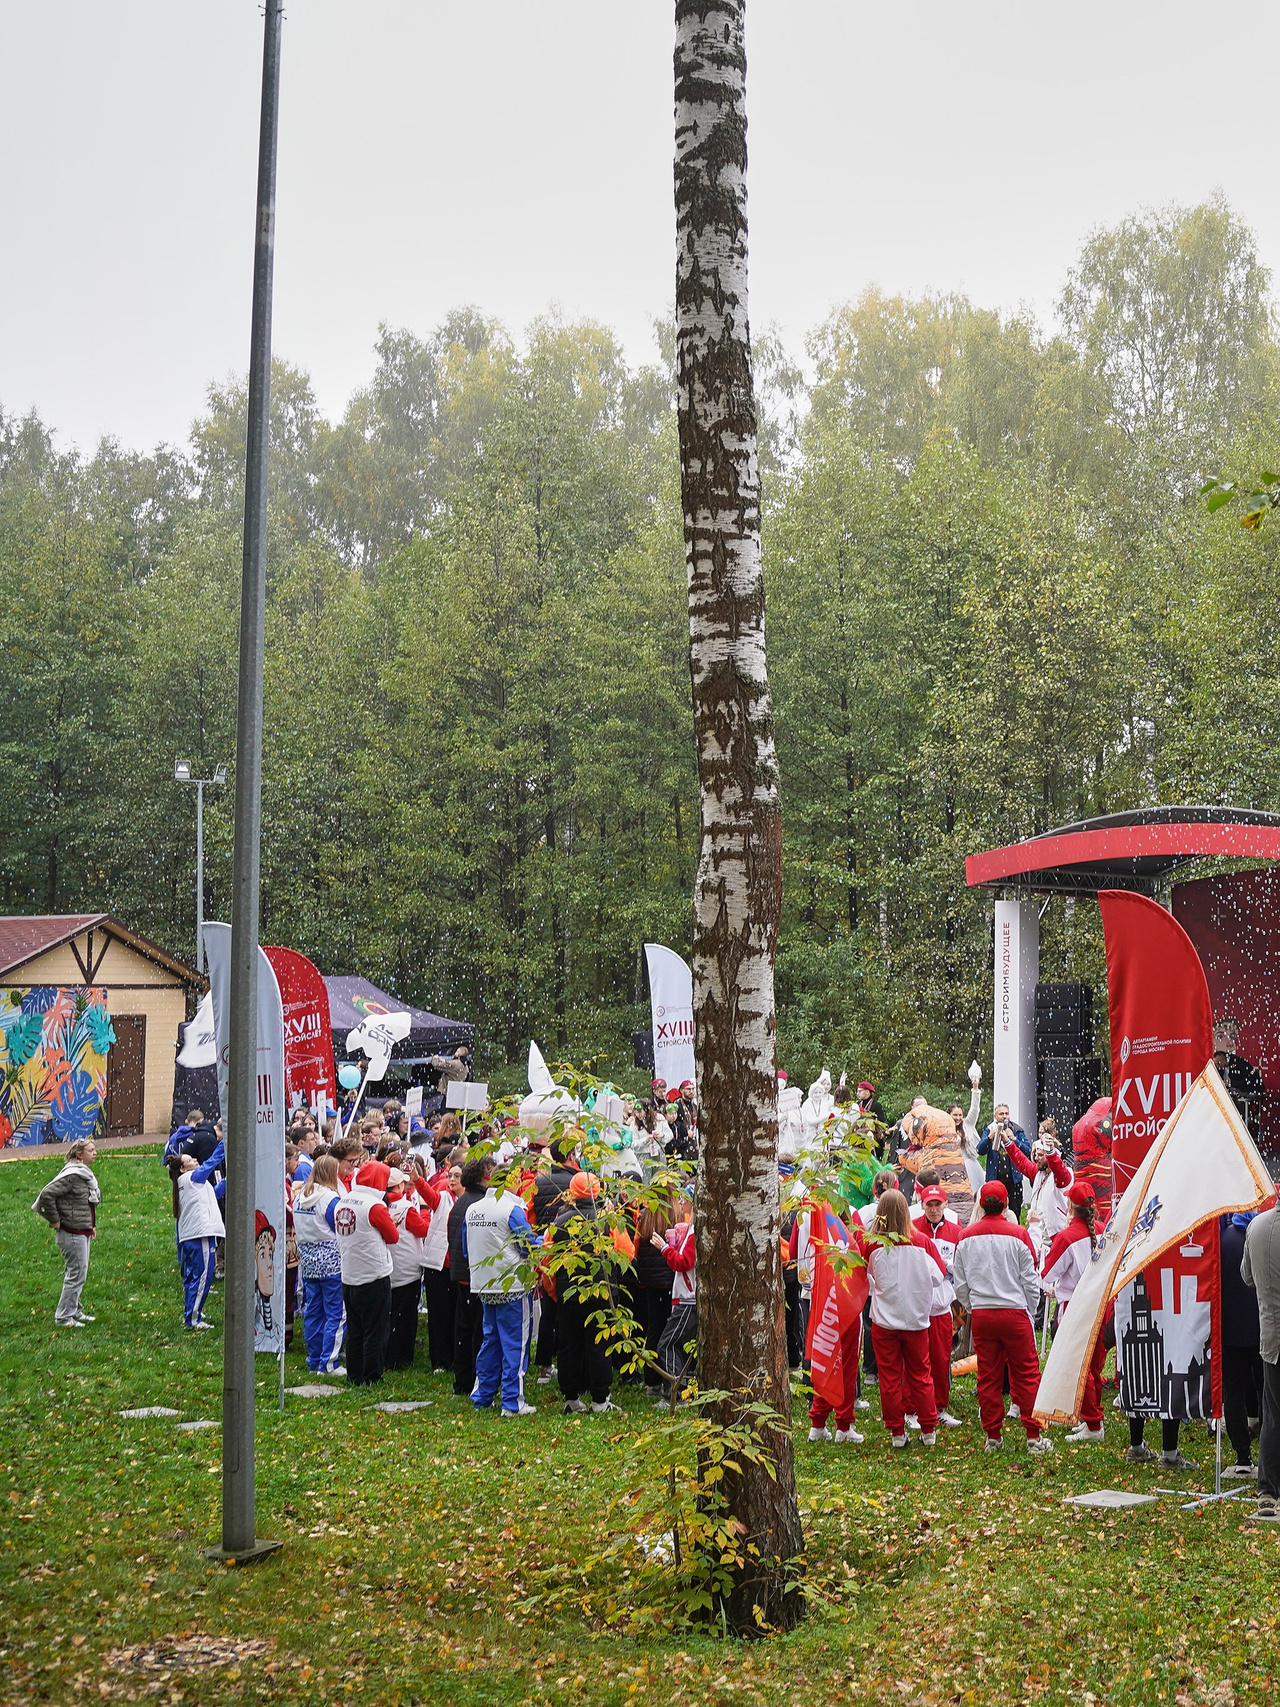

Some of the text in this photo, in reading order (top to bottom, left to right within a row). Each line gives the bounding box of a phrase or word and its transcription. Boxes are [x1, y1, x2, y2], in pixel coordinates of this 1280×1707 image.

[1002, 922, 1011, 1032] #СТРОИМБУДУЩЕЕ
[284, 1012, 321, 1038] XVIII
[657, 1020, 693, 1039] XVIII
